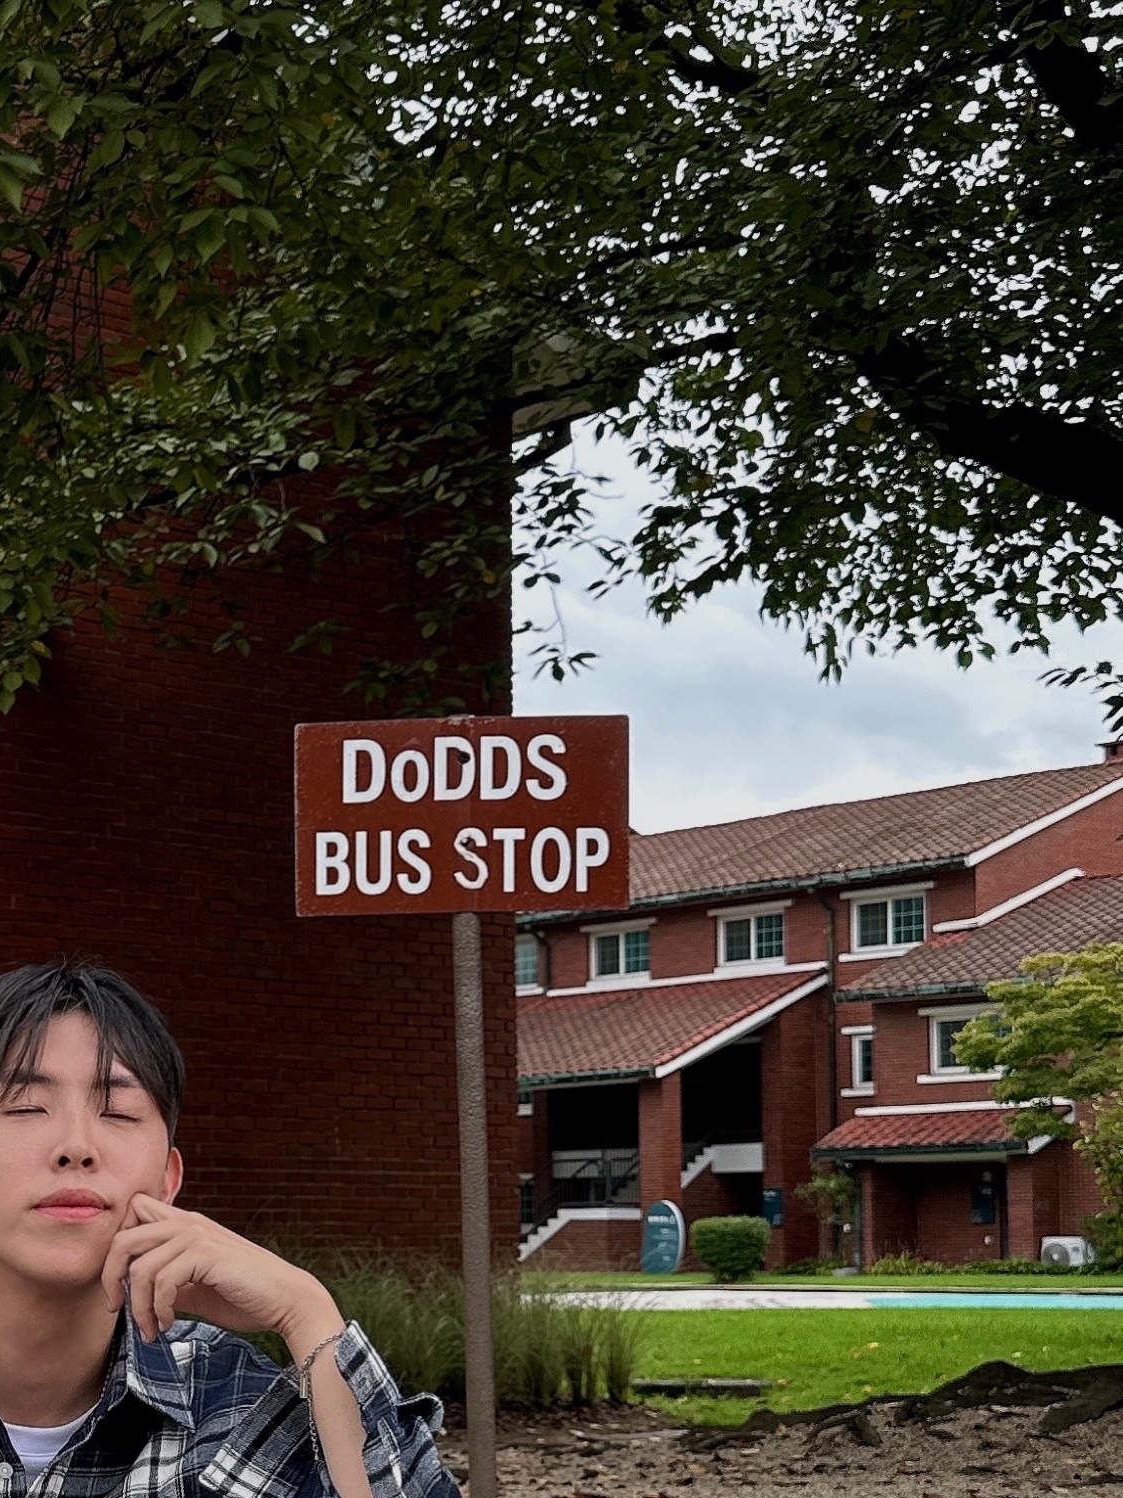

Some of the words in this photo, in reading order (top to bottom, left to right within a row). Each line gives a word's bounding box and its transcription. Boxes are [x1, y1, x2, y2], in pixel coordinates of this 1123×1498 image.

[342, 734, 567, 804] DoDDS
[315, 828, 432, 896] BUS
[453, 827, 610, 893] STOP
